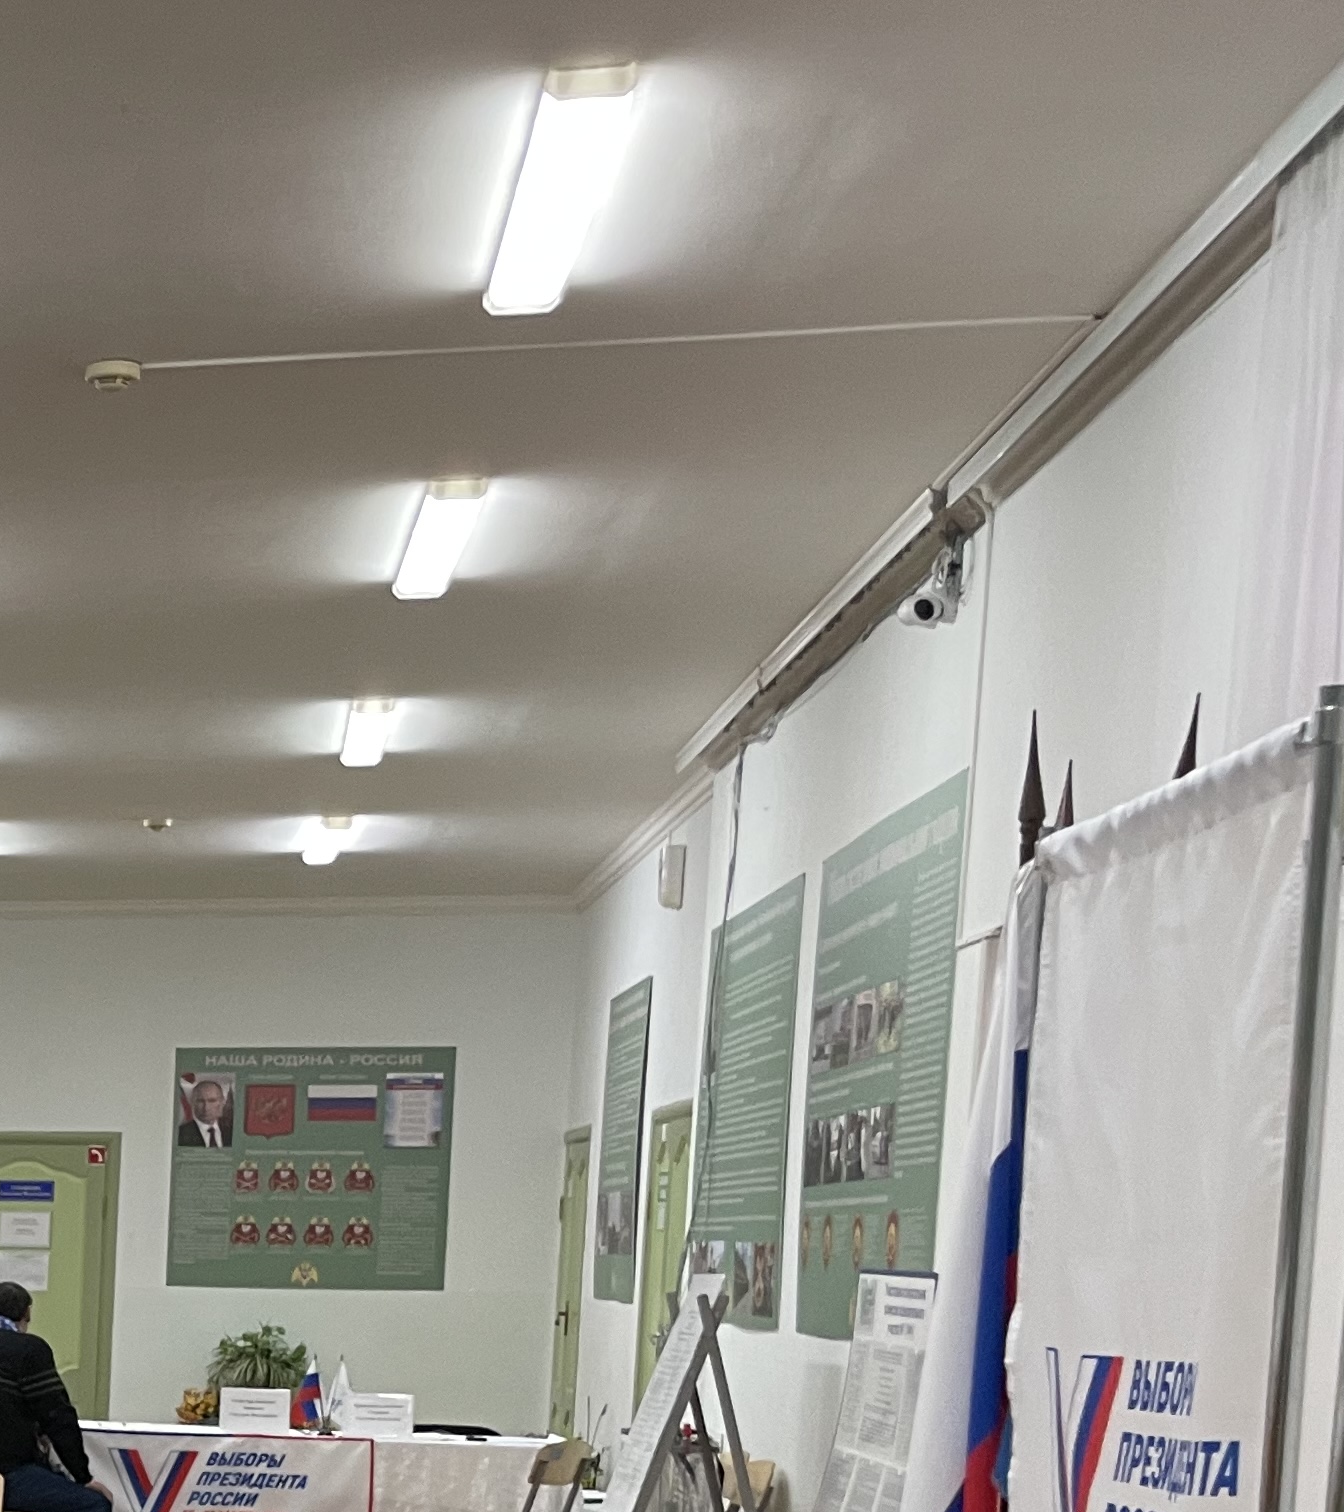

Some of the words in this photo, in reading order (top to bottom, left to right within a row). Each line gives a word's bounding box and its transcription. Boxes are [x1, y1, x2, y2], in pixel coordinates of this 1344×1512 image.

[205, 1054, 257, 1066] НАША
[262, 1053, 334, 1067] РОДИНА
[350, 1053, 424, 1066] РОССИЯ
[205, 1451, 287, 1469] ВЫБОРЫ
[195, 1471, 308, 1490] ПРЕЗИДЕНТА
[186, 1491, 260, 1507] РОССИИ
